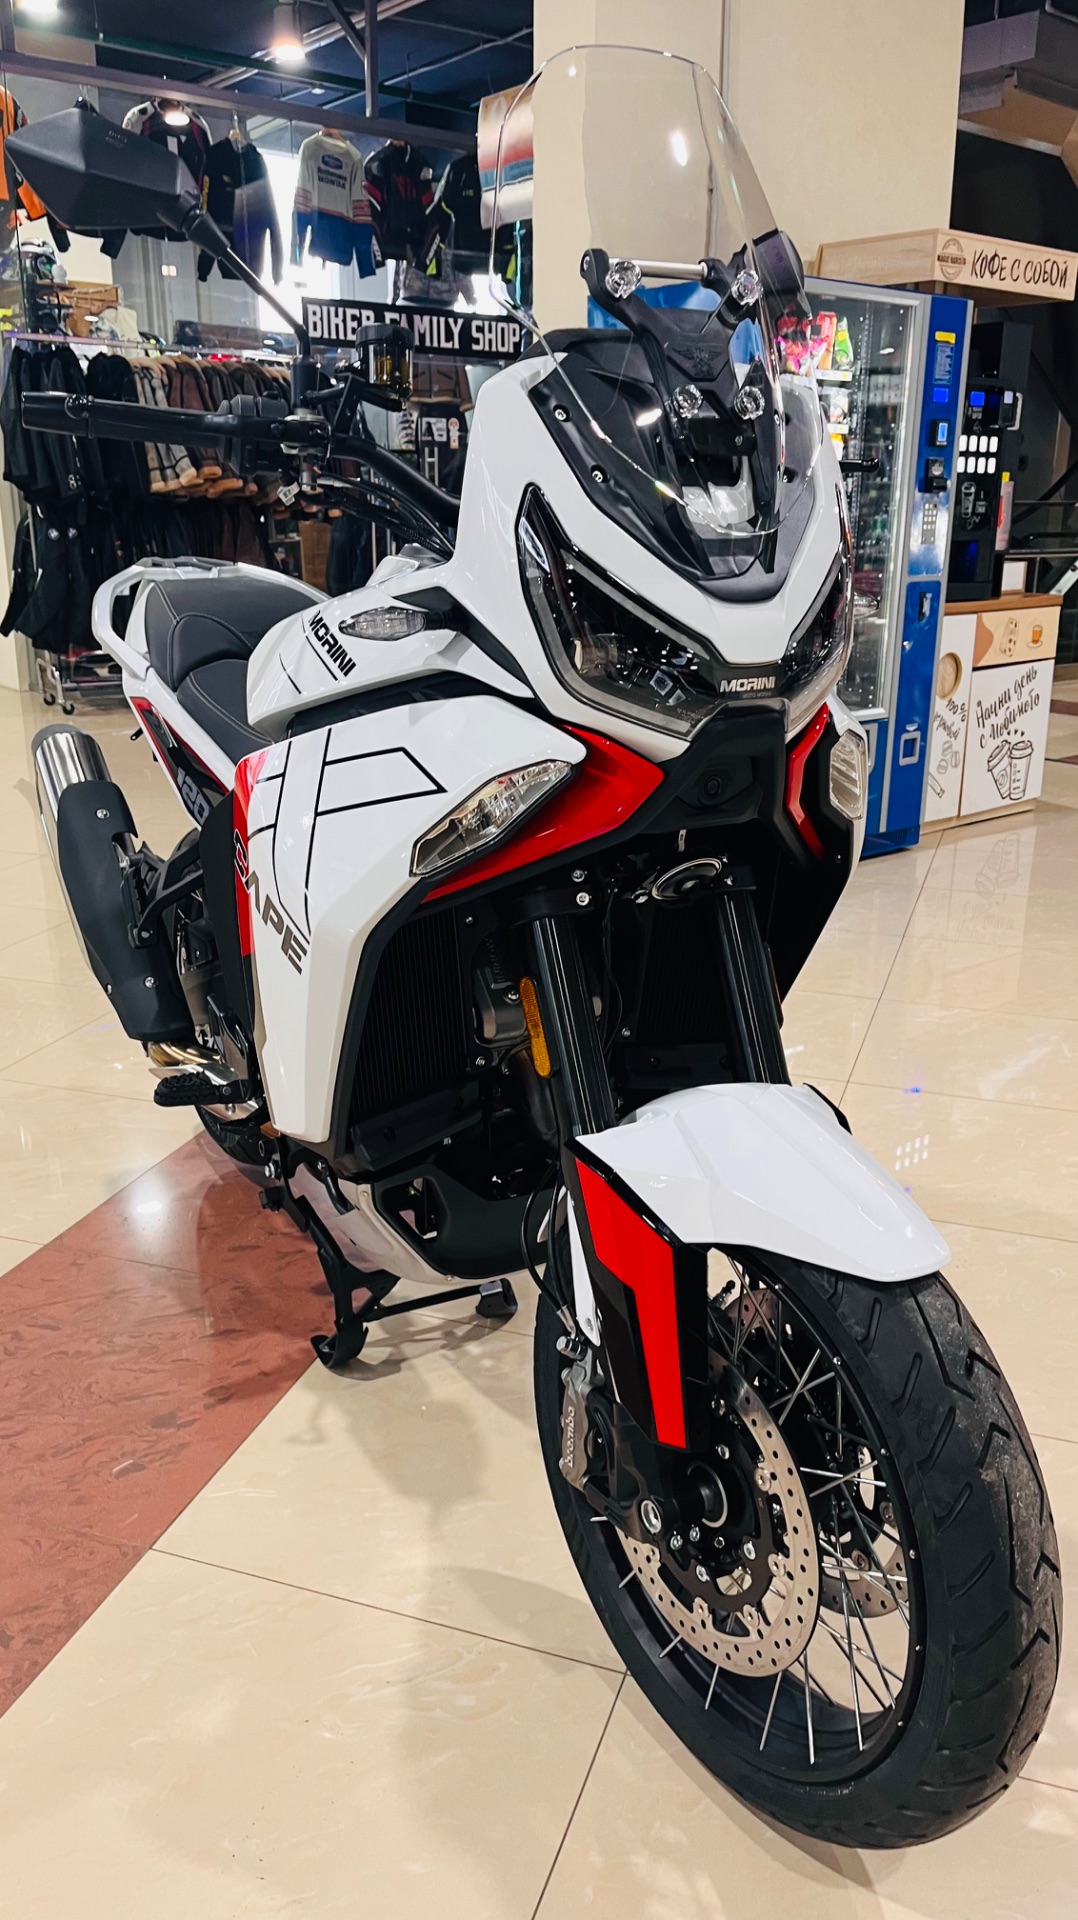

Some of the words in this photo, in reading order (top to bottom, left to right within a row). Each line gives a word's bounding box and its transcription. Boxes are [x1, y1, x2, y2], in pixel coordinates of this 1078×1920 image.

[971, 249, 1007, 281] КОФЕ
[1023, 259, 1068, 289] СОБОЙ
[471, 320, 520, 353] SHOP
[308, 610, 357, 678] MORINI
[720, 676, 776, 692] MORINI
[976, 688, 1011, 729] Начни
[1014, 665, 1038, 701] день
[564, 1406, 576, 1469] brembo
